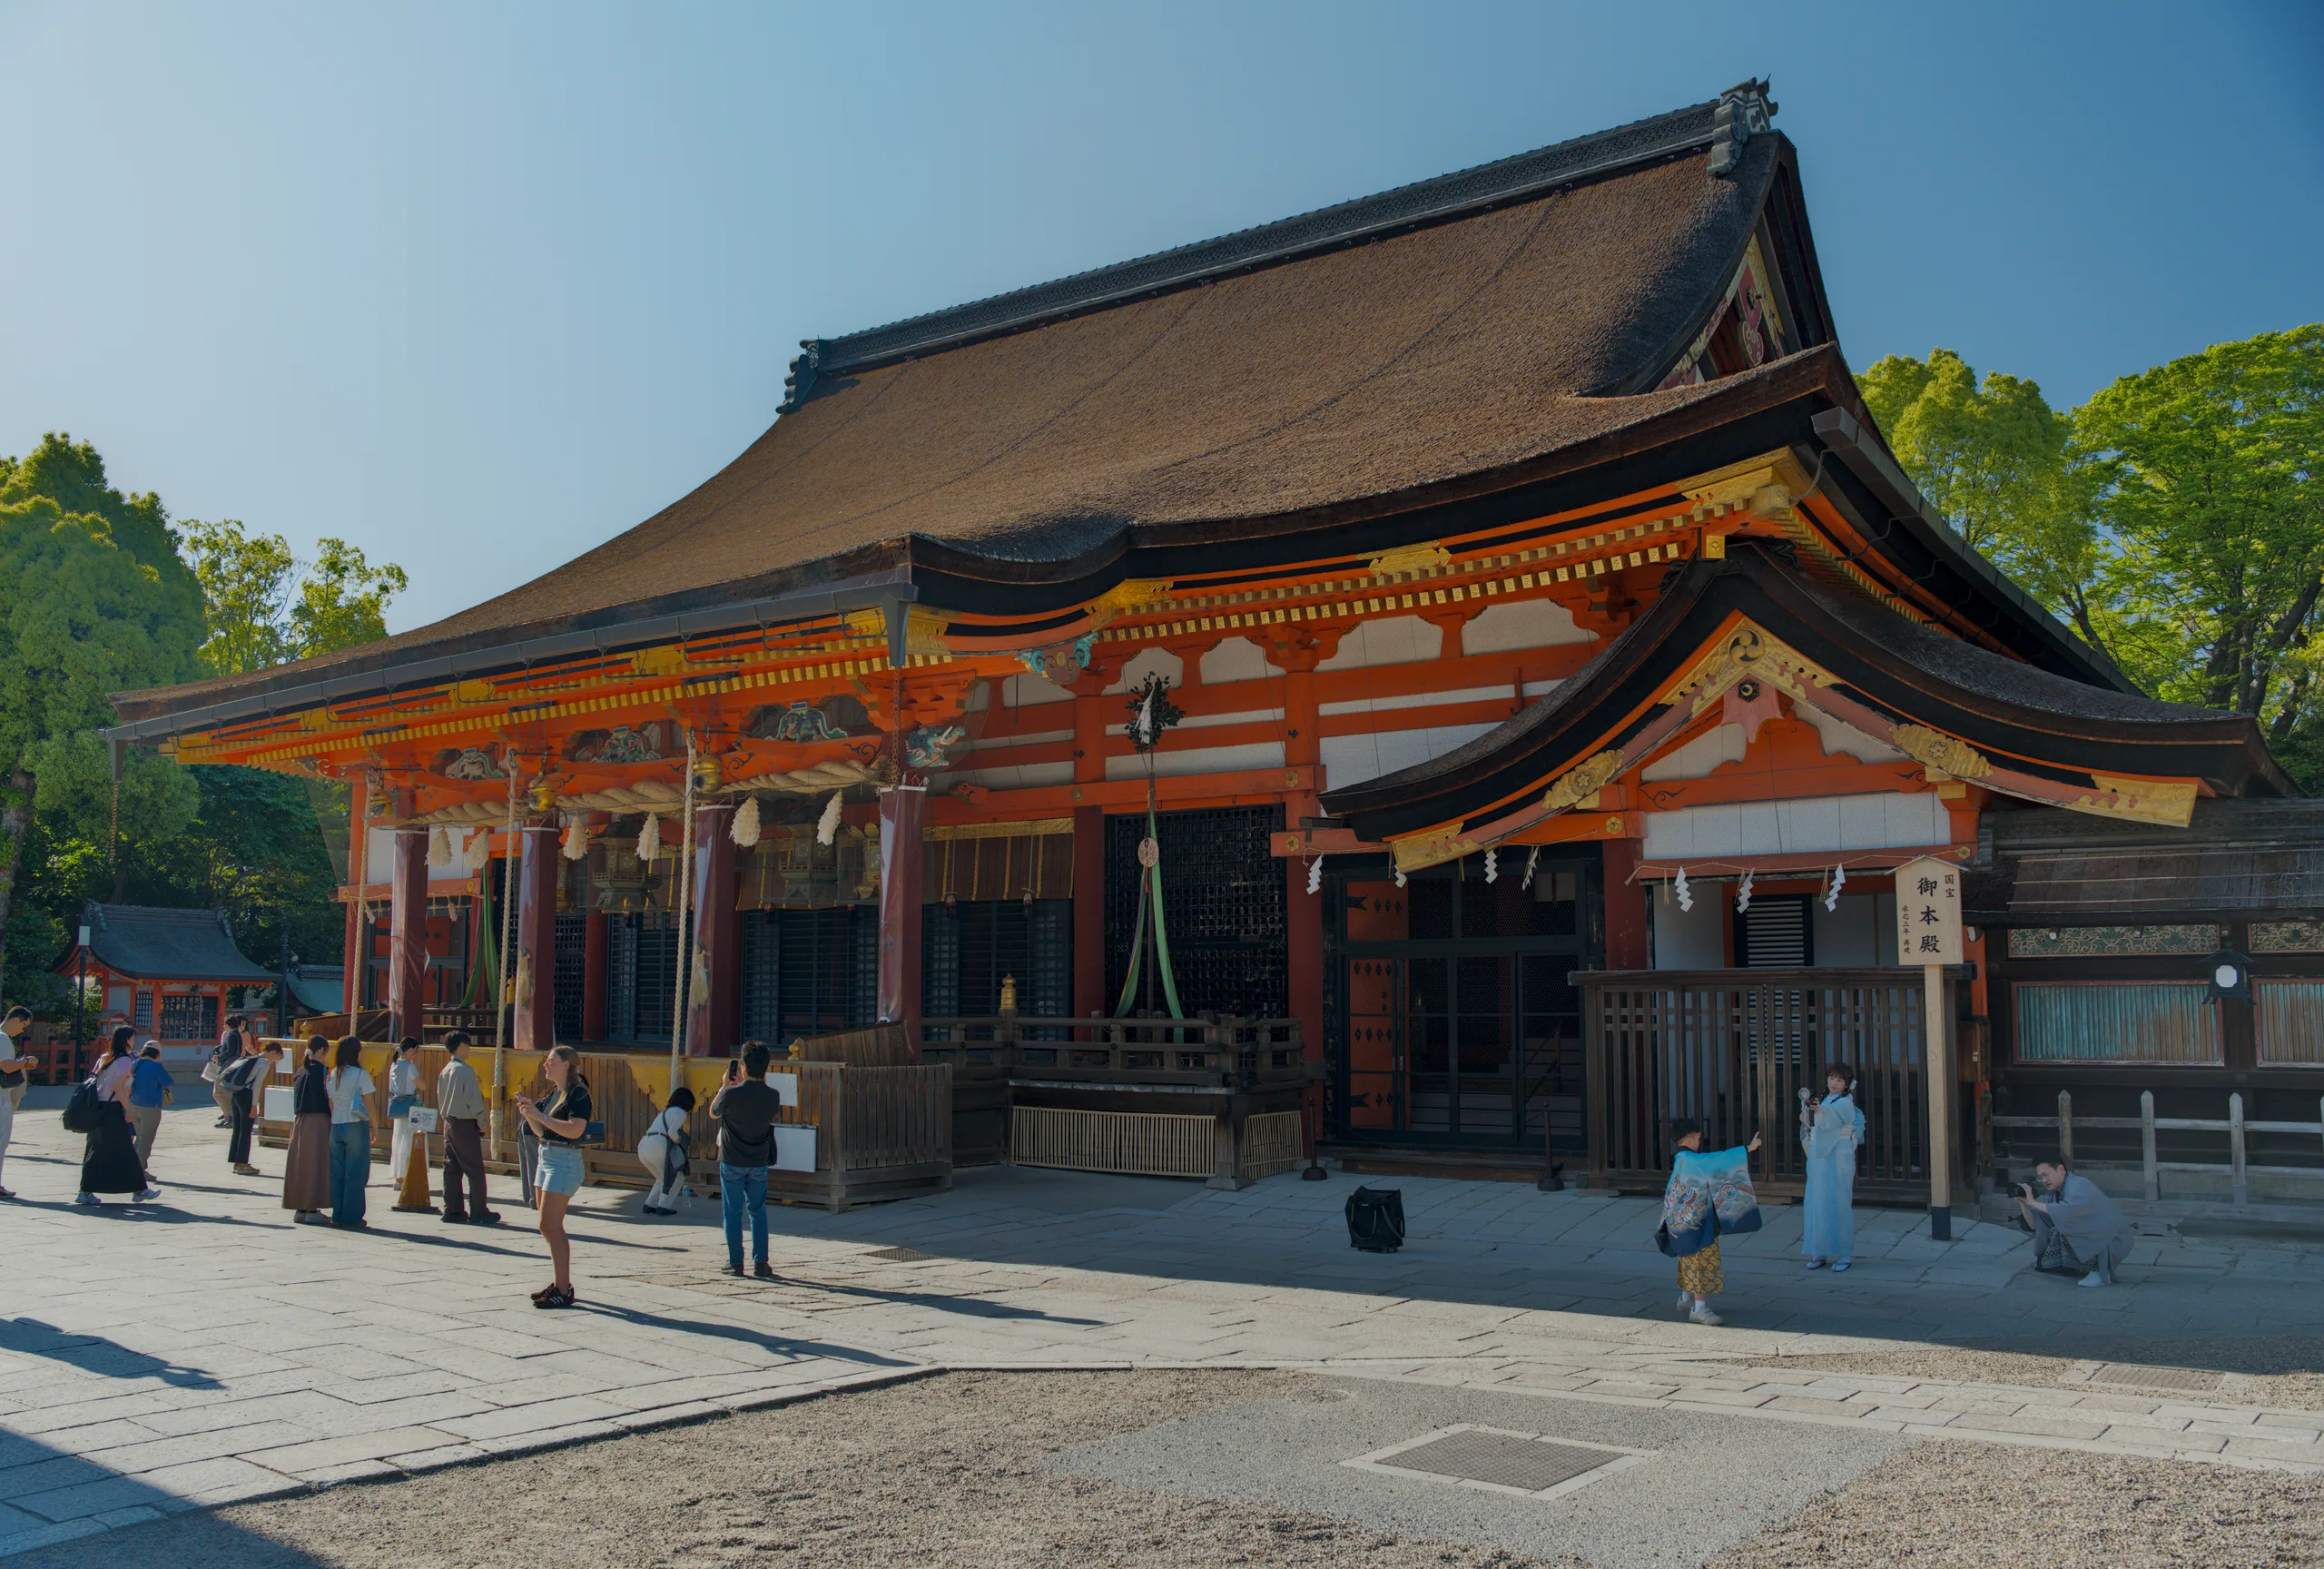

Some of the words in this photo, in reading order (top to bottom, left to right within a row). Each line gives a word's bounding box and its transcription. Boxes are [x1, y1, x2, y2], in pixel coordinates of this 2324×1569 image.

[1945, 874, 1955, 898] 国宝
[1916, 876, 1941, 953] 御本殿
